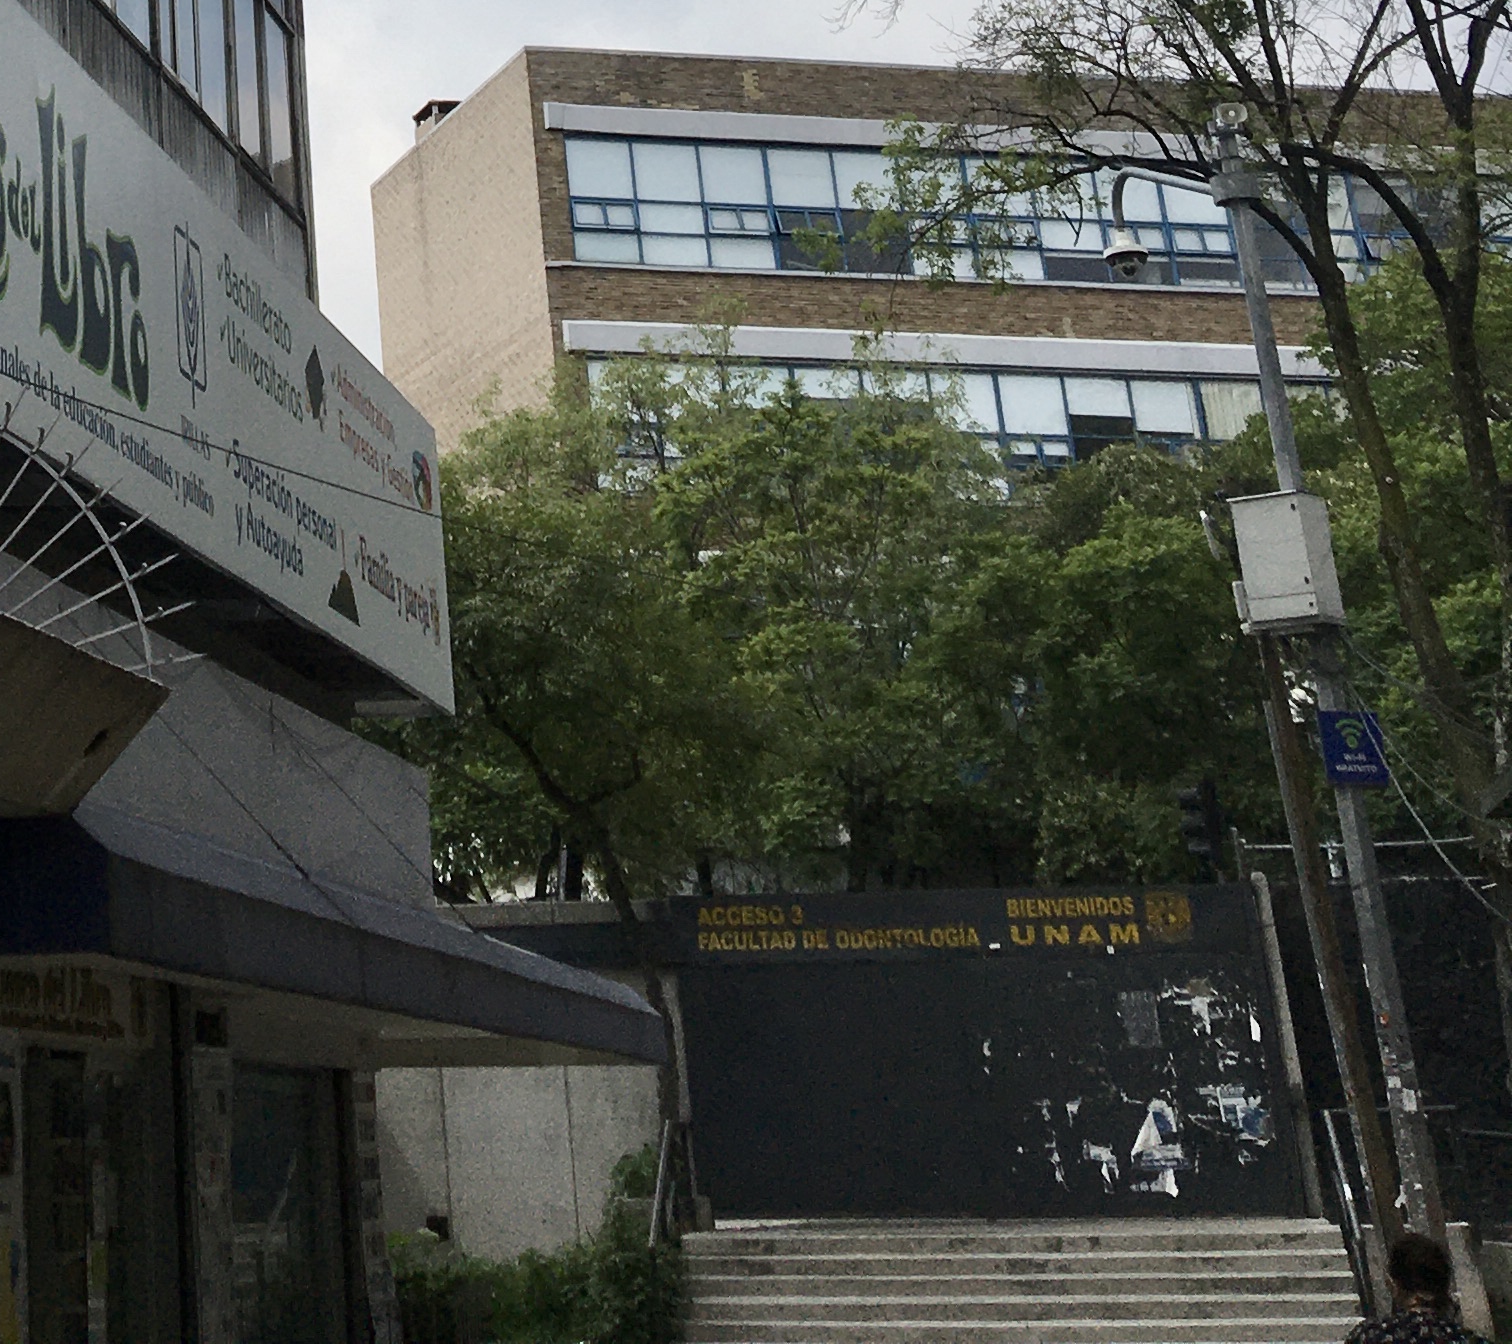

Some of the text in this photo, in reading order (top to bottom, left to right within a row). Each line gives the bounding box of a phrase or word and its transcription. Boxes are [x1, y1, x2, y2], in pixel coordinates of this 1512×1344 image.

[223, 252, 293, 355] Bachillerato
[225, 315, 305, 425] Universitarios
[33, 360, 48, 402] de
[49, 369, 62, 411] la
[120, 431, 174, 490] estudiantes
[232, 439, 337, 552] Superación personal
[235, 502, 304, 577] y Autoayuda
[697, 906, 785, 927] ACCESO
[697, 930, 796, 951] FACULTAD
[802, 929, 829, 950] DE
[1006, 896, 1135, 918] BIENVENIDOS
[1010, 922, 1140, 946] UNAM
